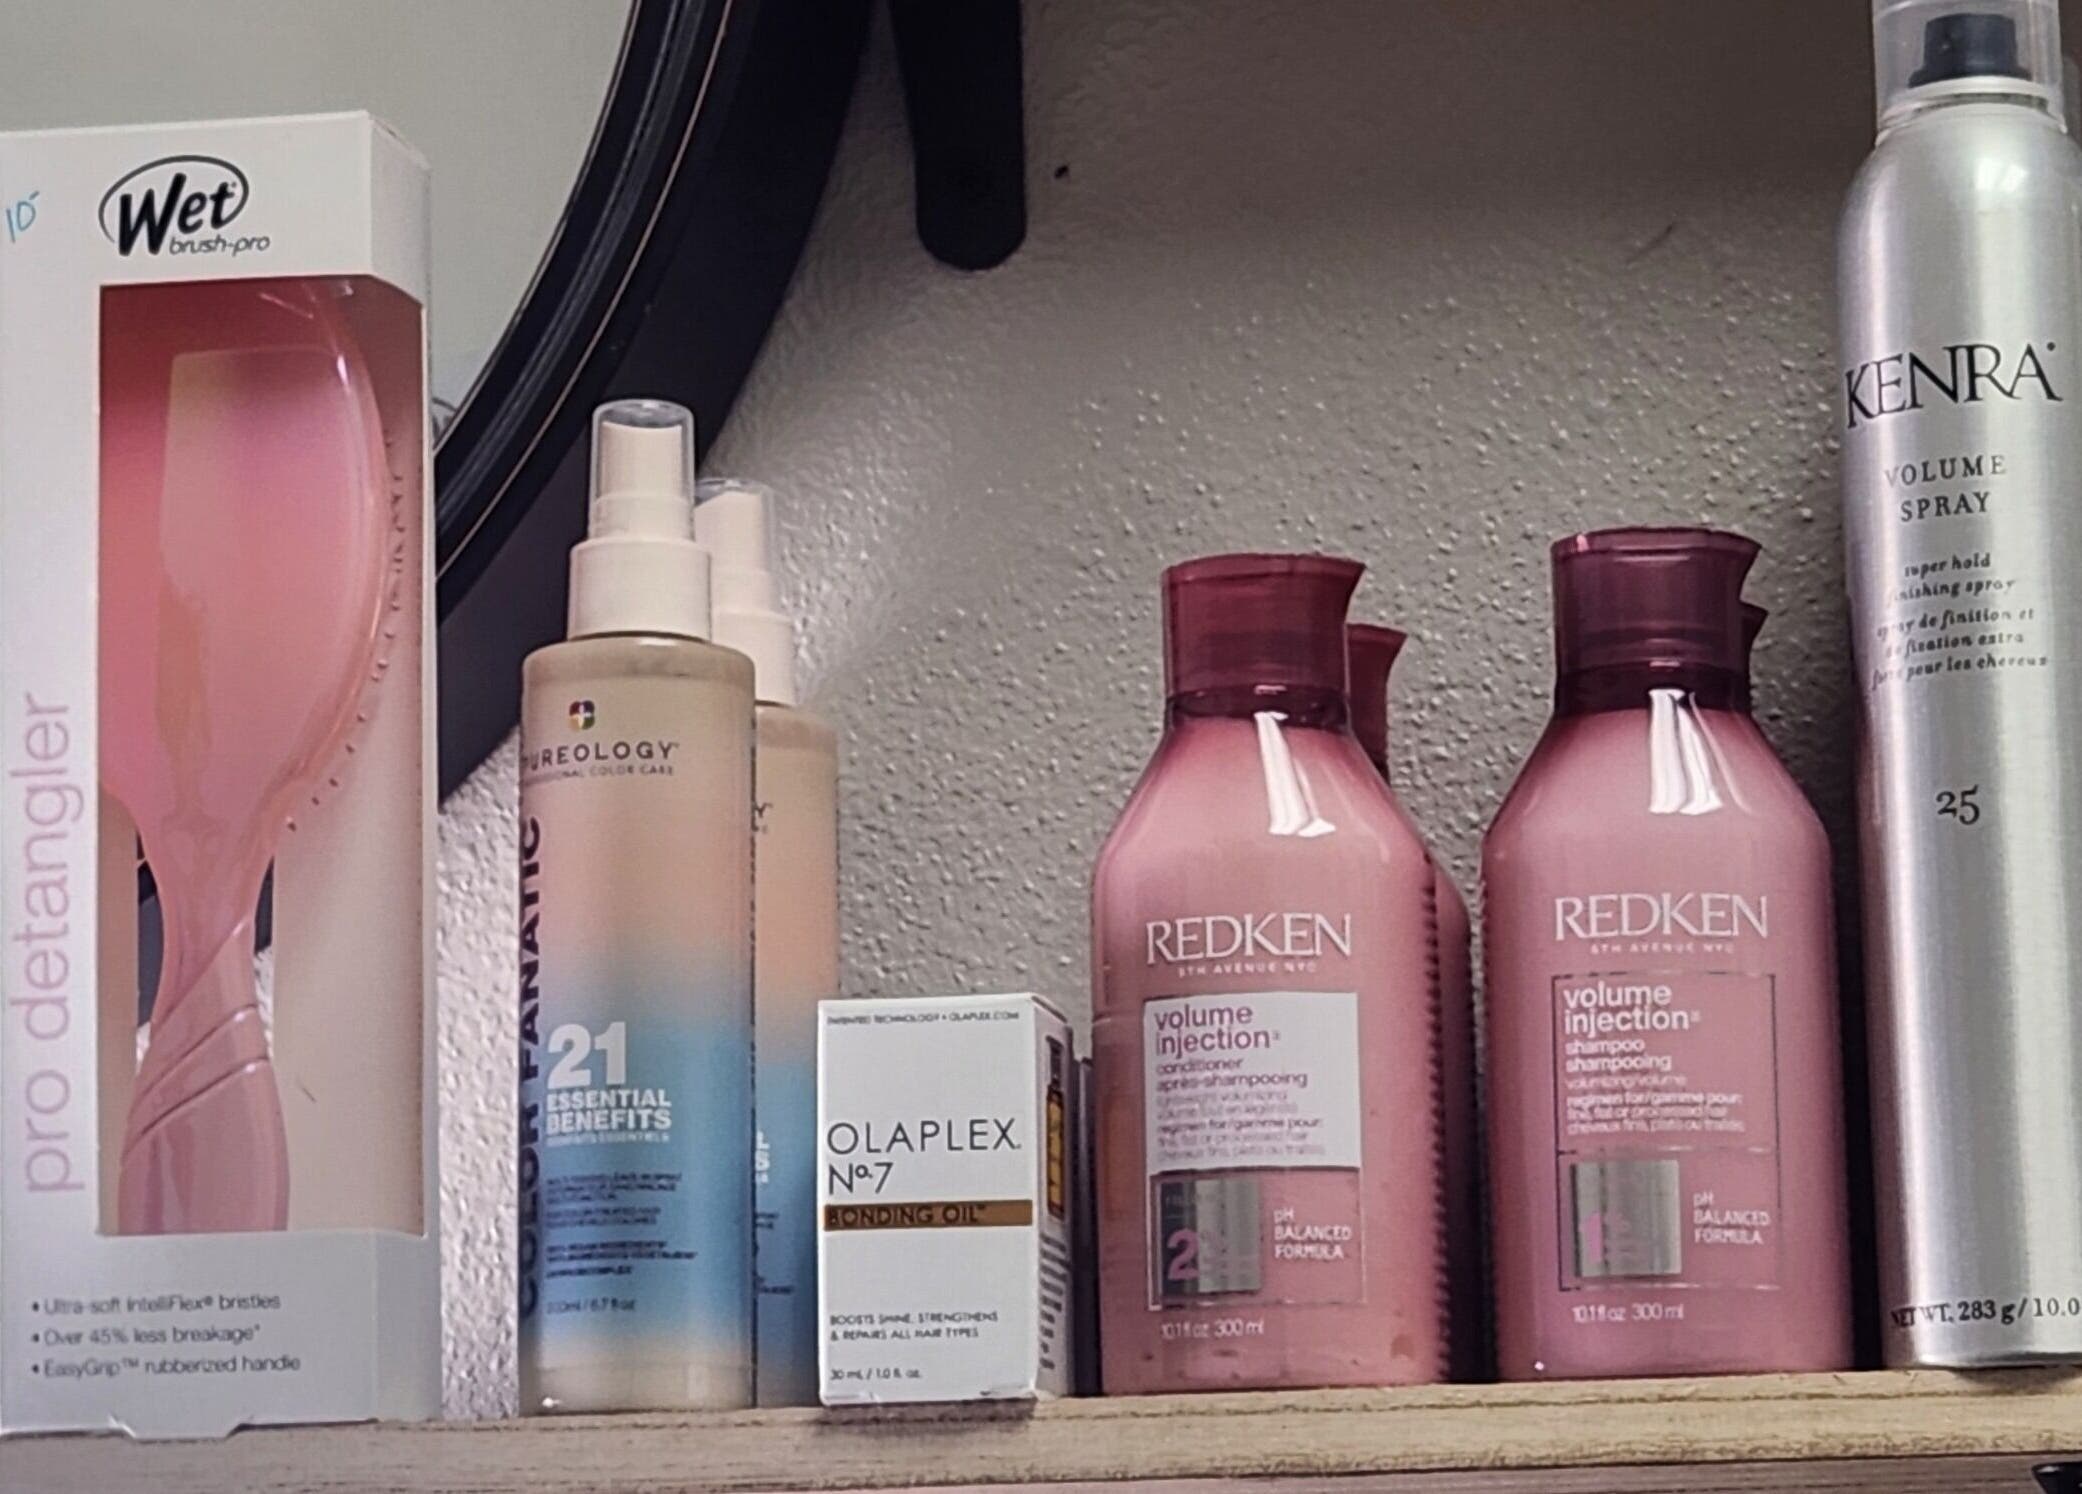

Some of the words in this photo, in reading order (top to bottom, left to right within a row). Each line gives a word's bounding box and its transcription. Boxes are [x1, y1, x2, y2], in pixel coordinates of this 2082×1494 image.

[119, 173, 237, 256] Wet
[169, 235, 270, 257] brush-pro
[1846, 342, 2064, 429] KENRA
[1885, 455, 2006, 487] VOLUME
[1901, 492, 1990, 522] SPRAY
[1904, 560, 1948, 580] super
[1951, 552, 1991, 570] hold
[1965, 579, 2016, 597] spray
[1906, 661, 1943, 683] pour
[1947, 655, 1972, 672] les
[1936, 784, 1981, 826] 25
[9, 691, 85, 1042] detangler
[1555, 892, 1768, 941] REDKEN
[1146, 912, 1352, 965] REDKEN
[1213, 962, 1277, 976] AVENUE
[1563, 981, 1673, 1009] volume
[1154, 1004, 1253, 1031] volume
[547, 1022, 626, 1089] 21
[1565, 1039, 1646, 1056] shampoo
[1156, 1058, 1244, 1076] conditioner
[1565, 1055, 1673, 1073] shampooing
[547, 1089, 672, 1112] ESSENTIAL
[24, 1068, 86, 1193] pro
[546, 1109, 672, 1137] BENEFITS
[827, 1118, 1018, 1155] OLAPLEX
[1694, 1209, 1770, 1227] BALANCED
[1274, 1225, 1352, 1241] BALANCED
[1695, 1228, 1763, 1245] FORMULA
[1167, 1228, 1200, 1280] 2
[1275, 1243, 1345, 1260] FORMULA
[219, 1294, 281, 1310] bristles
[1631, 1303, 1662, 1320] 300
[1957, 1299, 1997, 1322] 283
[830, 1314, 875, 1327] BOOSTS
[918, 1310, 999, 1324] STRENGTHENS
[1214, 1319, 1244, 1337] 300
[44, 1330, 83, 1346] Over
[89, 1329, 129, 1345] 45%
[133, 1327, 167, 1344] less
[842, 1328, 888, 1341] REPAIRS
[891, 1328, 911, 1339] ALL
[914, 1327, 943, 1339] HAIR
[945, 1326, 979, 1339] TYPES
[145, 1354, 237, 1375] rubberized
[242, 1353, 301, 1373] handle
